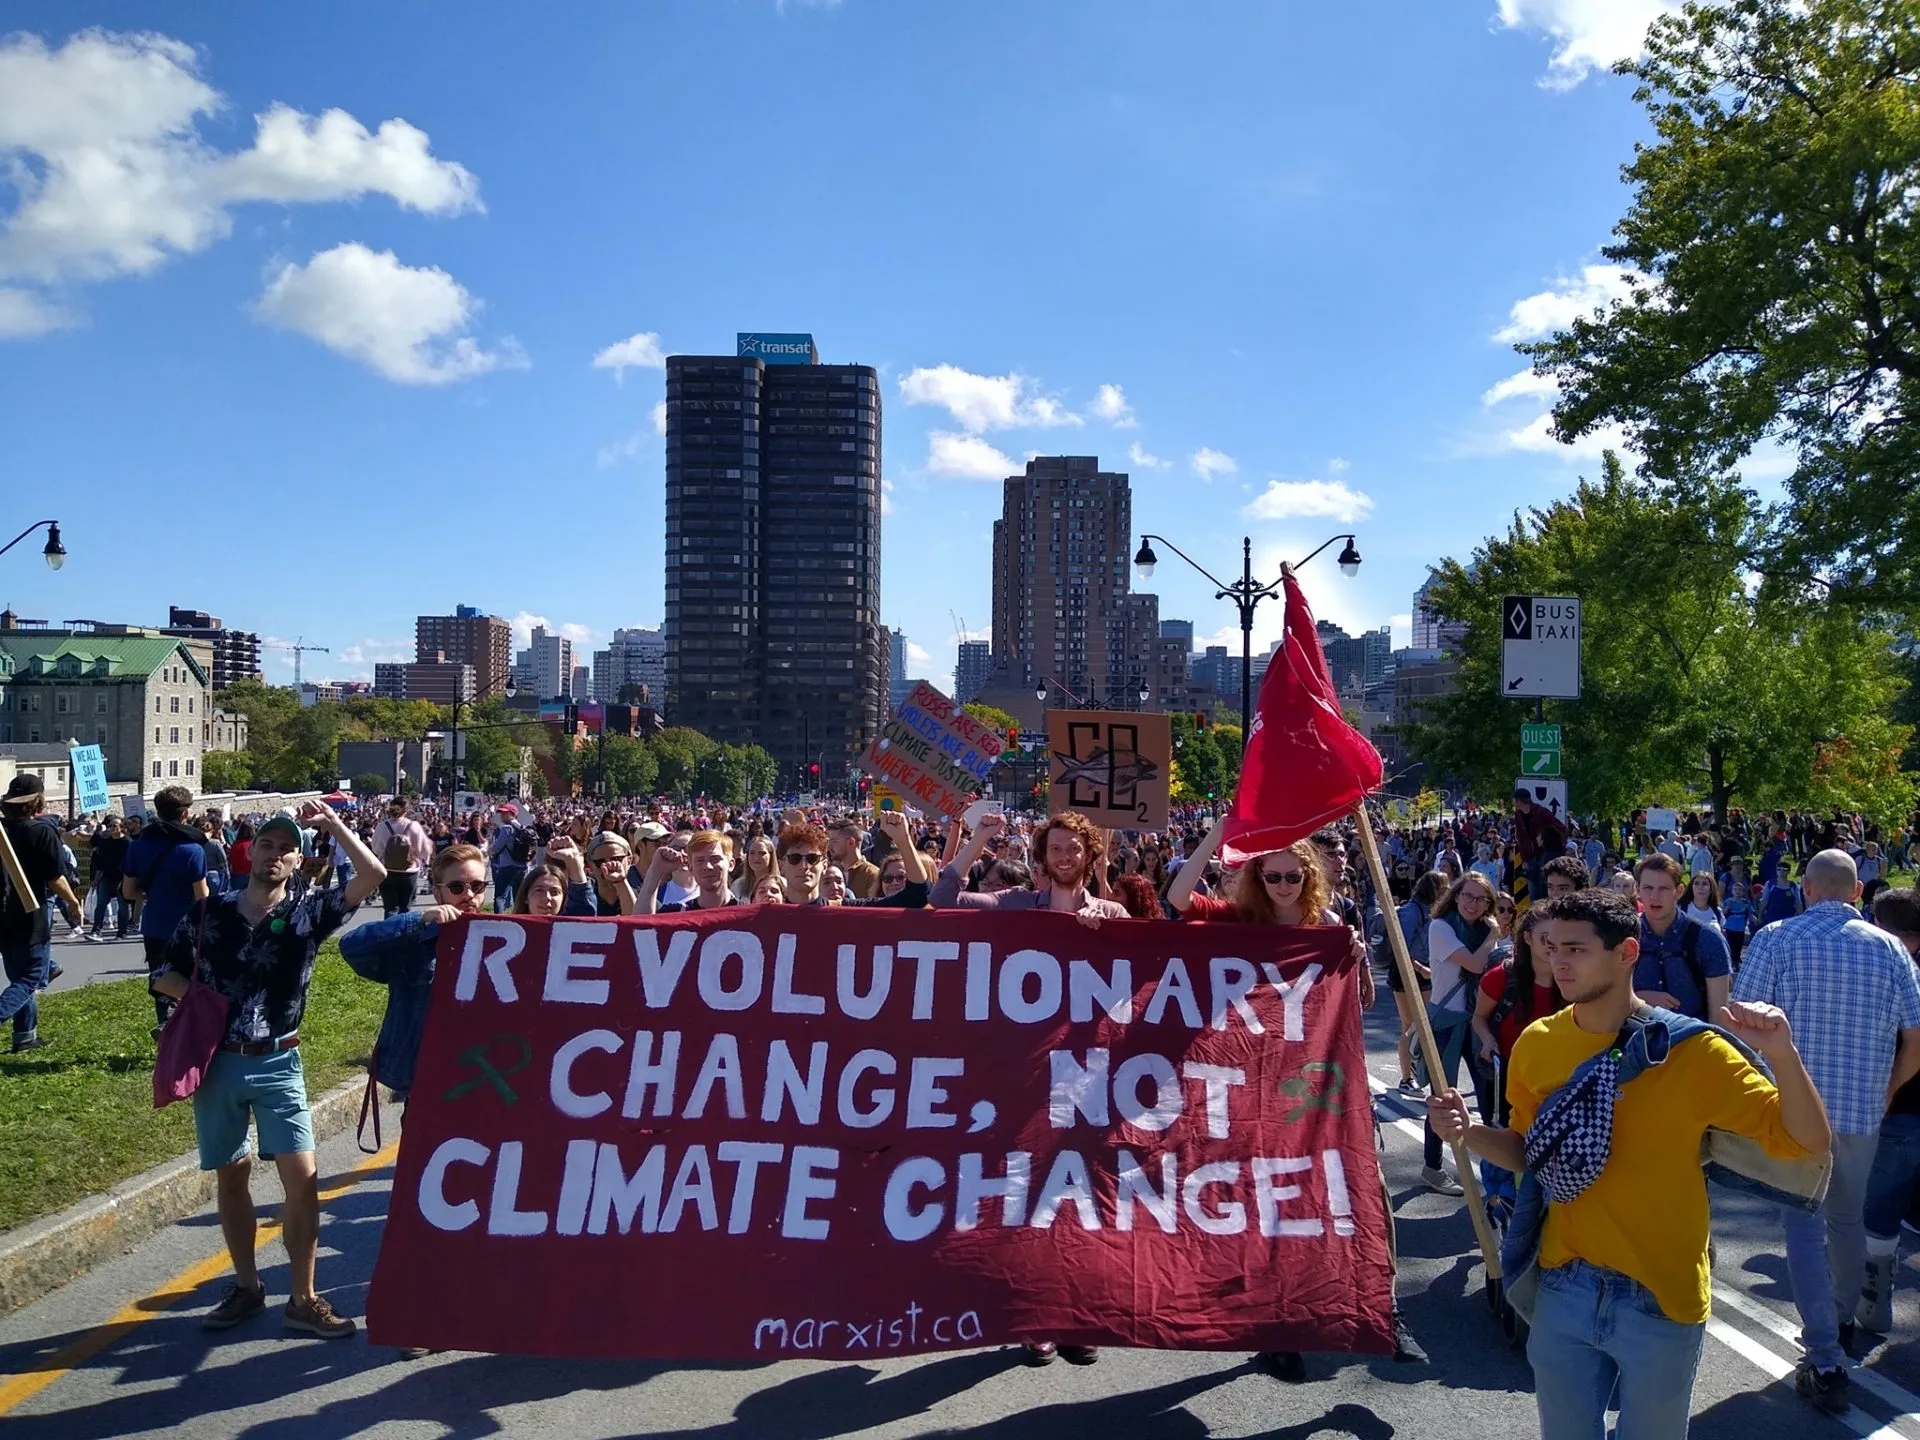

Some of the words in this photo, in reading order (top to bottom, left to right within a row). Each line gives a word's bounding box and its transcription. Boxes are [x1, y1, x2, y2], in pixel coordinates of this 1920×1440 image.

[760, 341, 811, 354] transat
[1535, 605, 1576, 620] BUS
[1535, 624, 1576, 640] TAXI
[909, 684, 953, 721] ROSES
[950, 714, 980, 741] ARE
[975, 732, 1002, 757] RED
[882, 721, 933, 763] CLIMATE
[896, 701, 943, 741] VIOLETS
[938, 732, 967, 758] ARE
[960, 749, 993, 781] BLUE
[1523, 730, 1559, 744] OUEST
[75, 750, 87, 763] WE
[86, 748, 97, 761] ALL
[82, 764, 96, 777] SAW
[868, 741, 919, 787] WHERE
[910, 770, 942, 804] ARE
[82, 792, 107, 808] COMING
[85, 779, 99, 792] THIS
[454, 919, 1323, 1042] REVOLUTIONARY
[549, 1028, 998, 1133] CHANGE,
[1048, 1047, 1246, 1139] NOT
[417, 1137, 840, 1240] CLIMATE
[882, 1149, 1355, 1242] CHANGE!
[754, 1300, 983, 1349] marxist.ca
